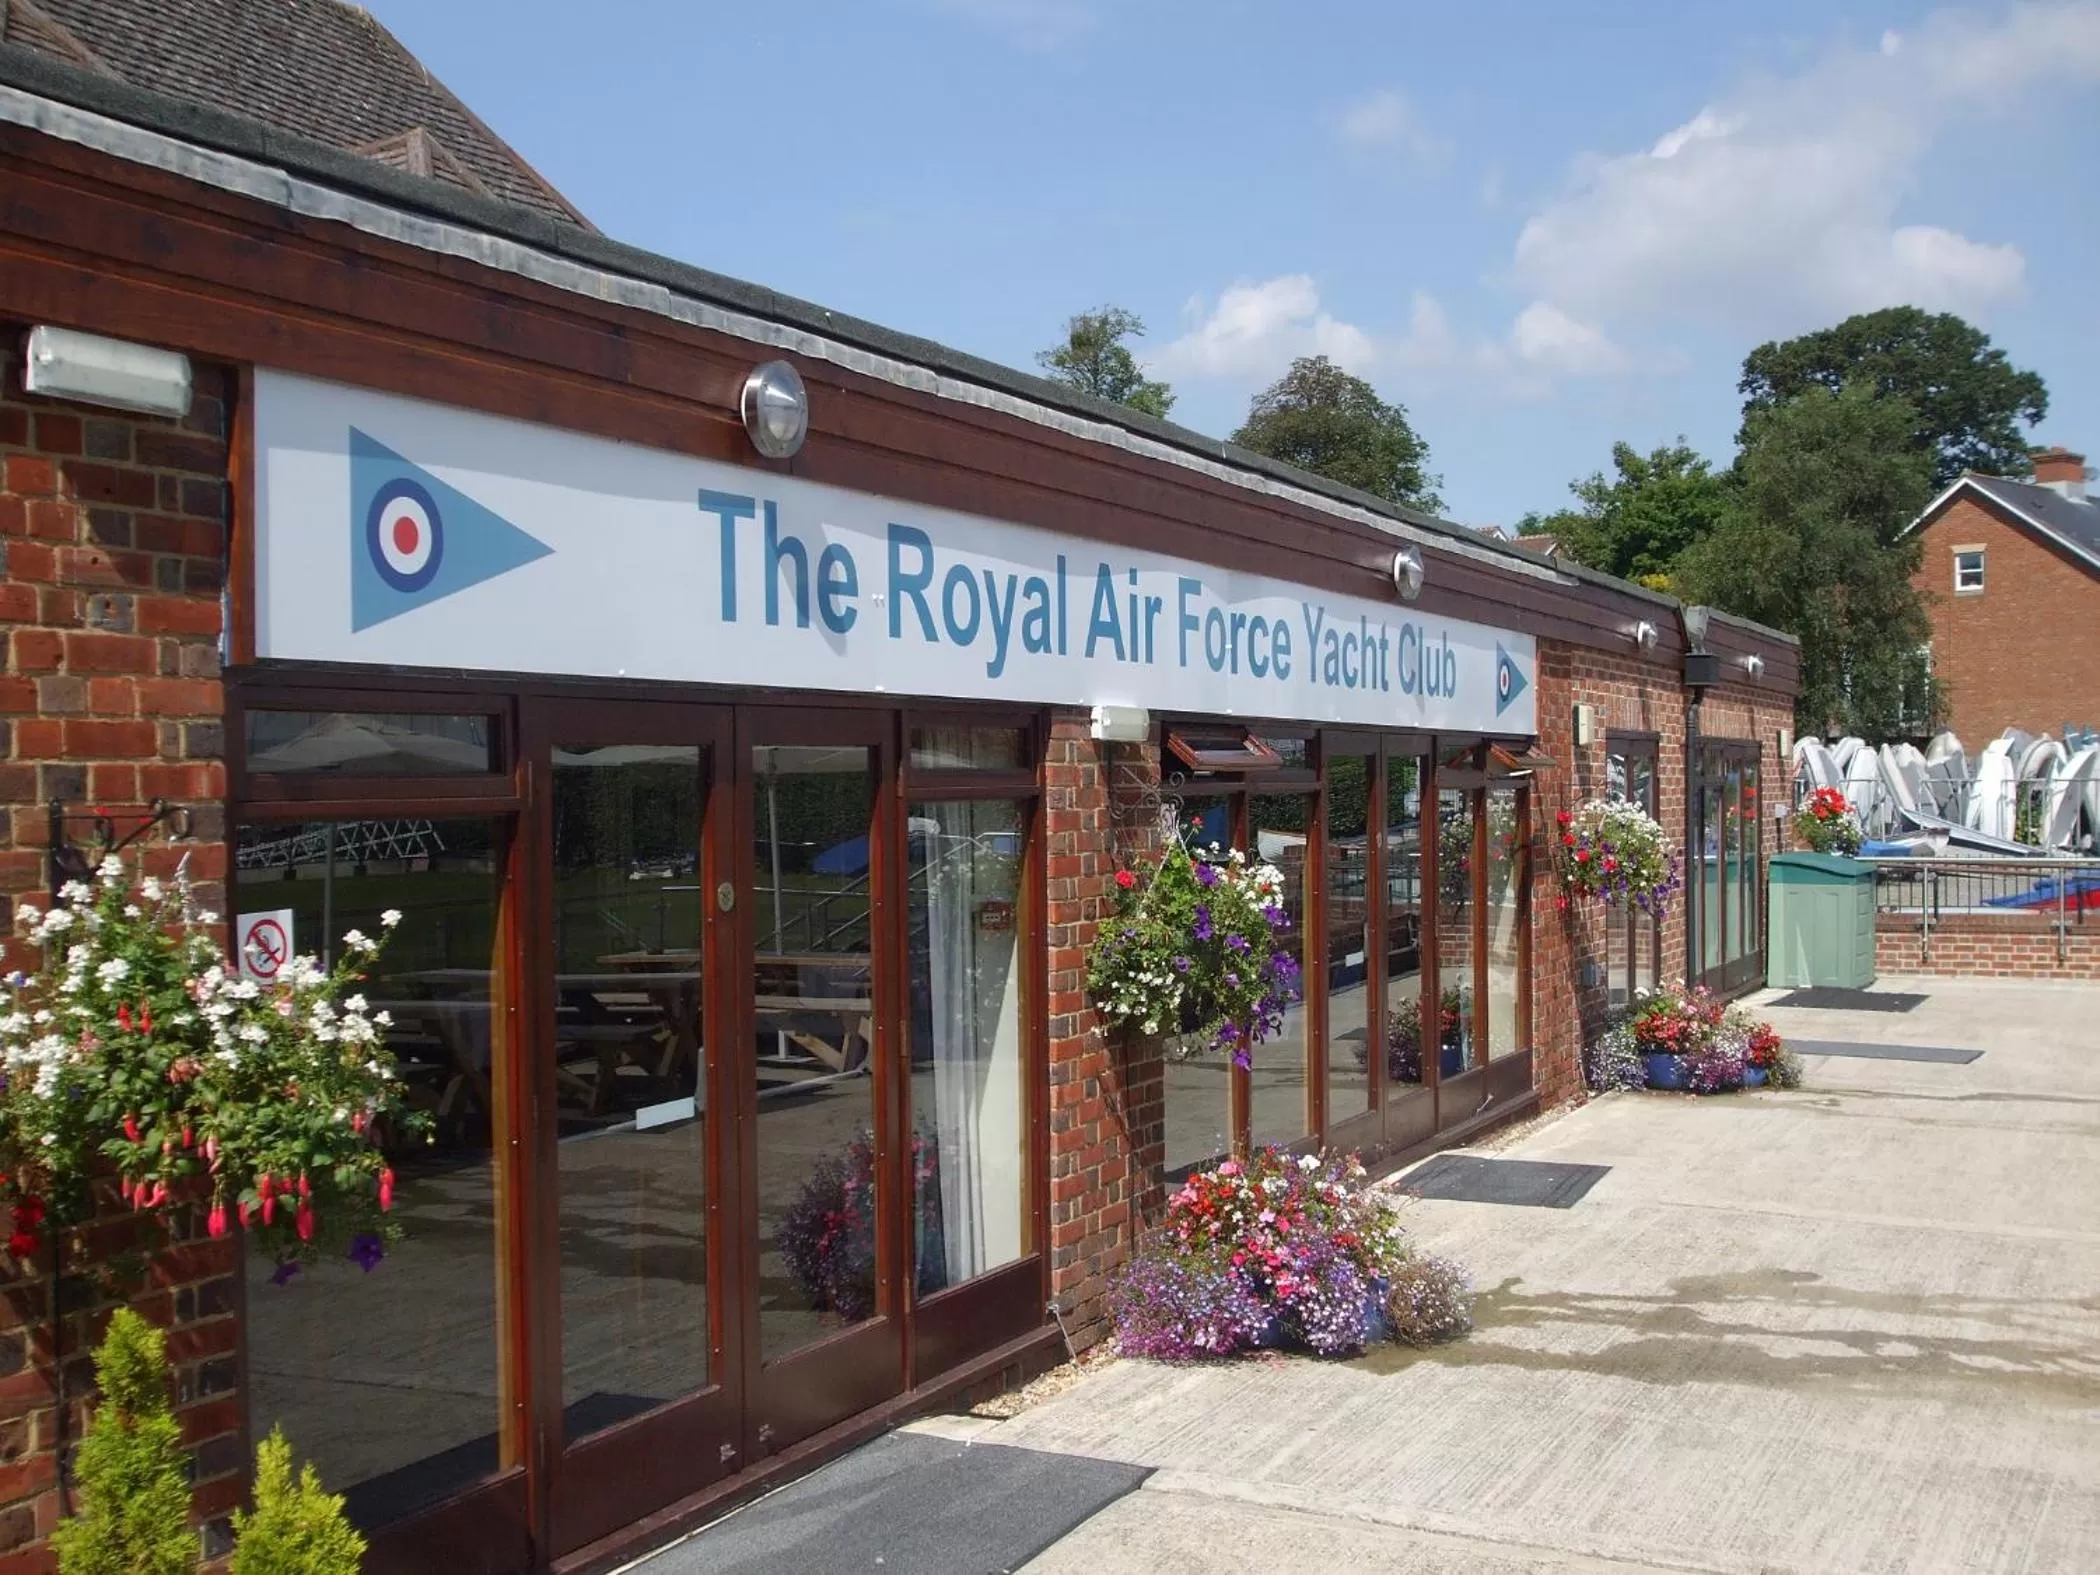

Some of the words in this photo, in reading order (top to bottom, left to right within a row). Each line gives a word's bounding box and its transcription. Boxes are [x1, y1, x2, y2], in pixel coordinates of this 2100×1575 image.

[698, 488, 859, 634] The
[888, 523, 1067, 679] Royal
[1085, 562, 1162, 664] Air
[1178, 577, 1291, 680] Force
[1302, 602, 1388, 692] Yacht
[1399, 623, 1456, 699] Club
